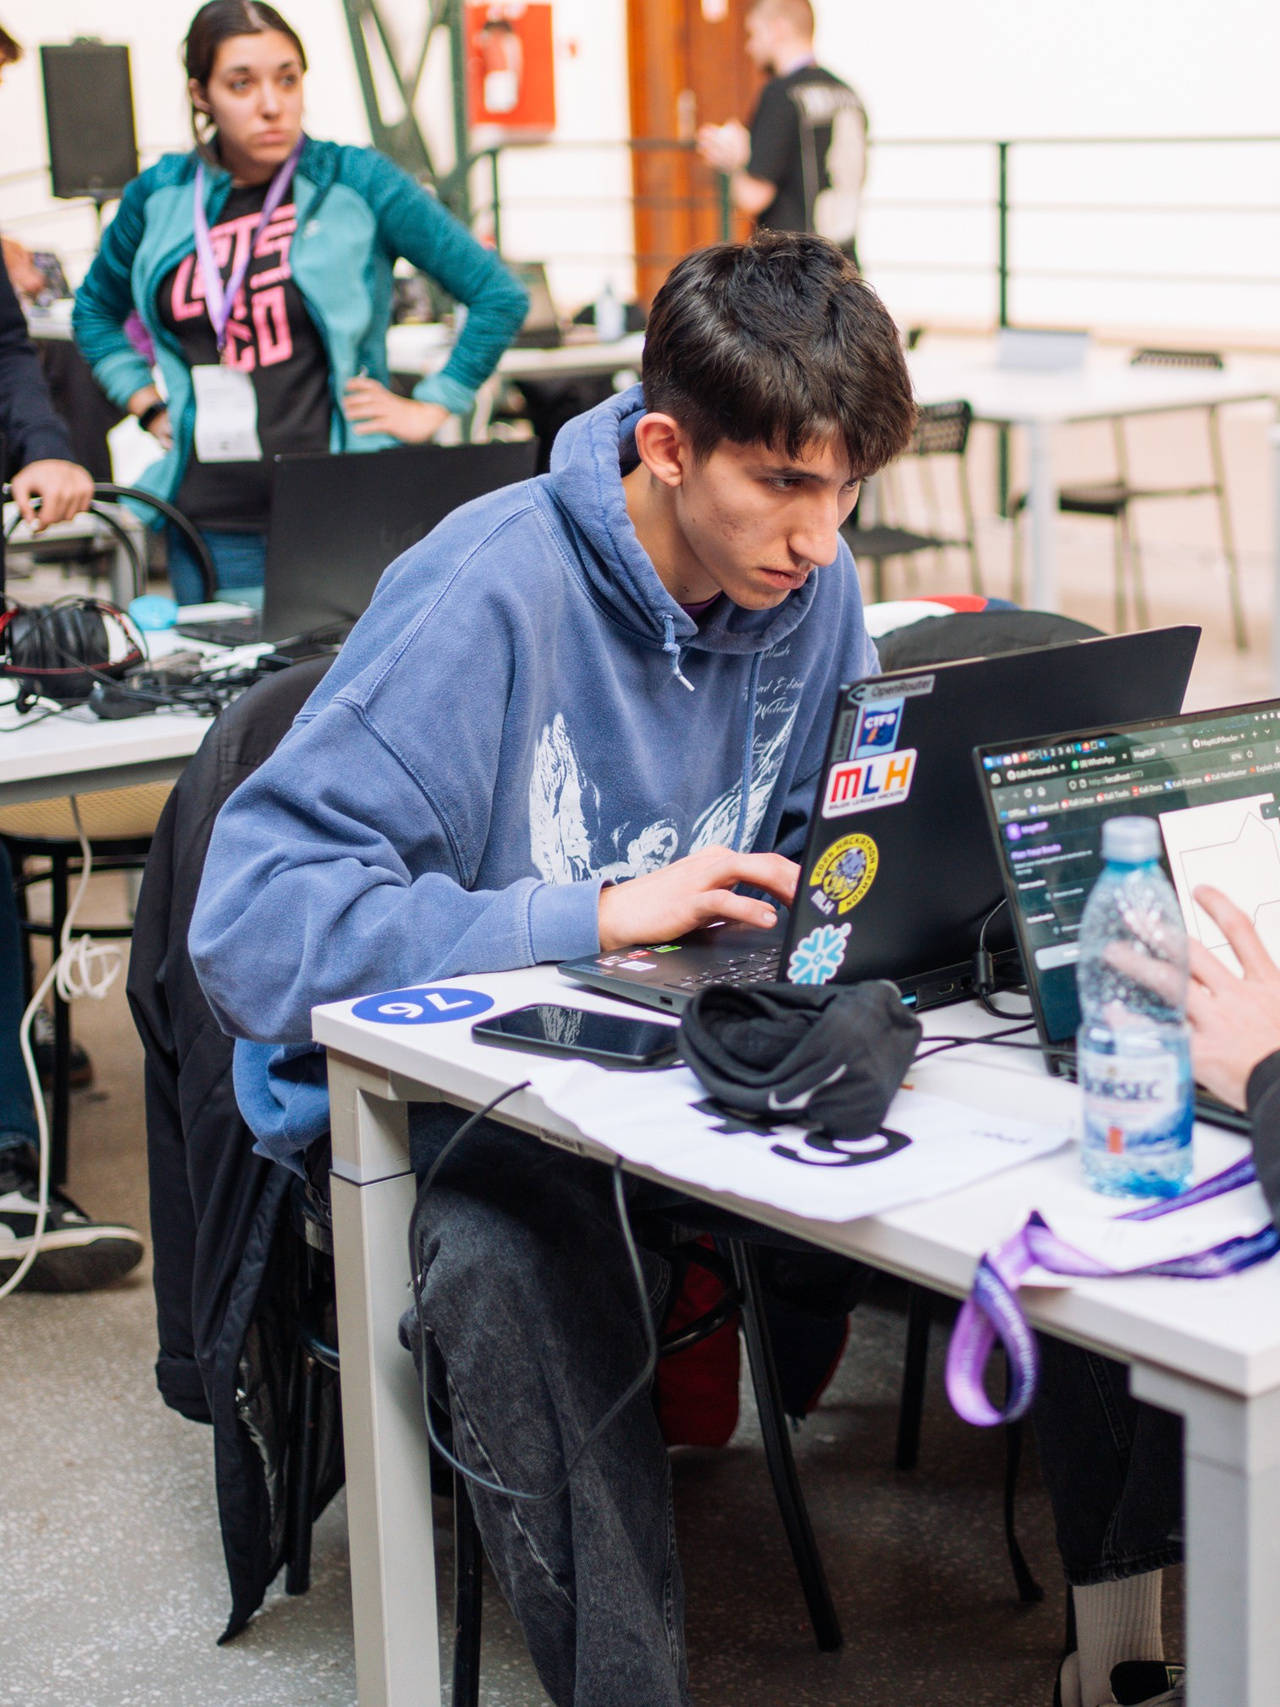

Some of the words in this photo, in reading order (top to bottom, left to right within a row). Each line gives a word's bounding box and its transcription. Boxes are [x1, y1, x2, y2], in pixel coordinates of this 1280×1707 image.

[871, 680, 931, 697] OpenRouter
[1088, 756, 1116, 768] WhatsApp
[830, 756, 911, 802] MLH
[1182, 776, 1202, 787] Forums
[1222, 768, 1247, 779] NetHunter
[852, 796, 876, 806] LEAGUE
[878, 789, 905, 799] HACKING
[836, 836, 876, 864] HACKATHON
[846, 868, 875, 906] SEASON
[810, 889, 835, 915] MLH
